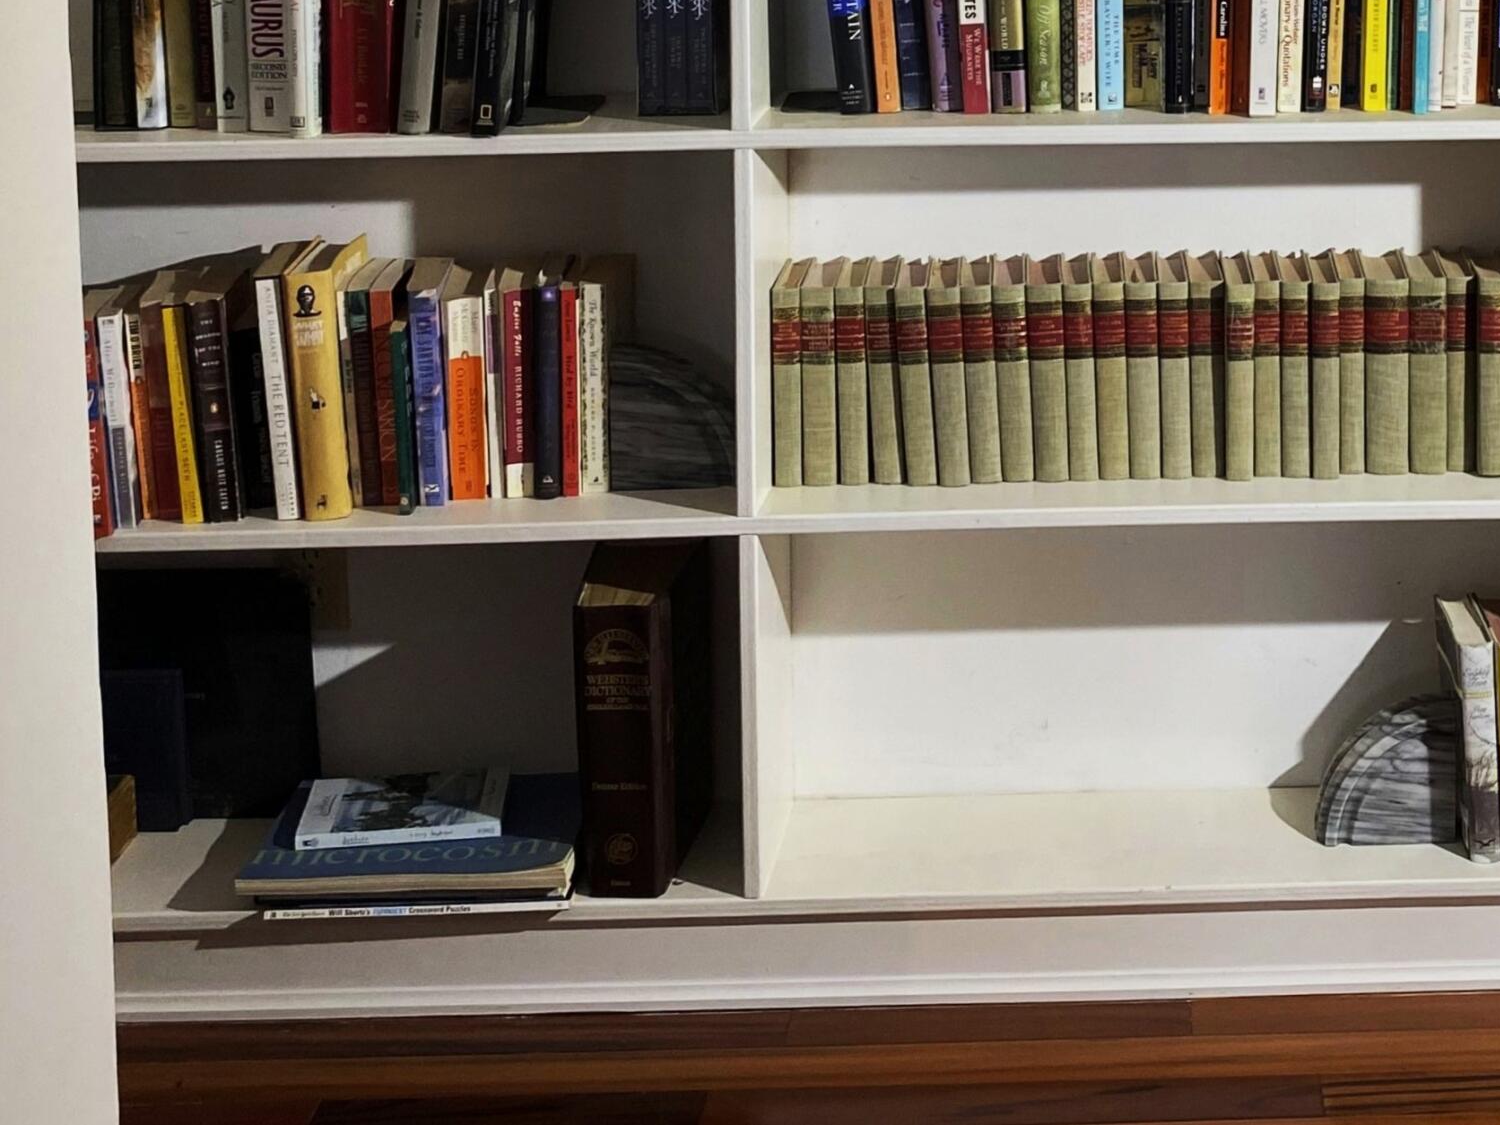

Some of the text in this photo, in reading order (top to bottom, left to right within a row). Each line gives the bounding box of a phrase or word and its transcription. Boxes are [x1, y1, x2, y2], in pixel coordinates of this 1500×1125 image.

[999, 17, 1009, 50] WORLD
[1219, 0, 1228, 37] Carolina
[1320, 5, 1328, 35] DOWN
[1038, 25, 1052, 67] Season
[1281, 34, 1292, 87] Quotations
[1319, 38, 1327, 70] UNDER
[128, 320, 142, 370] TIM O'BRIEN
[515, 366, 523, 414] RICHARD
[271, 373, 289, 468] THE RED TENT
